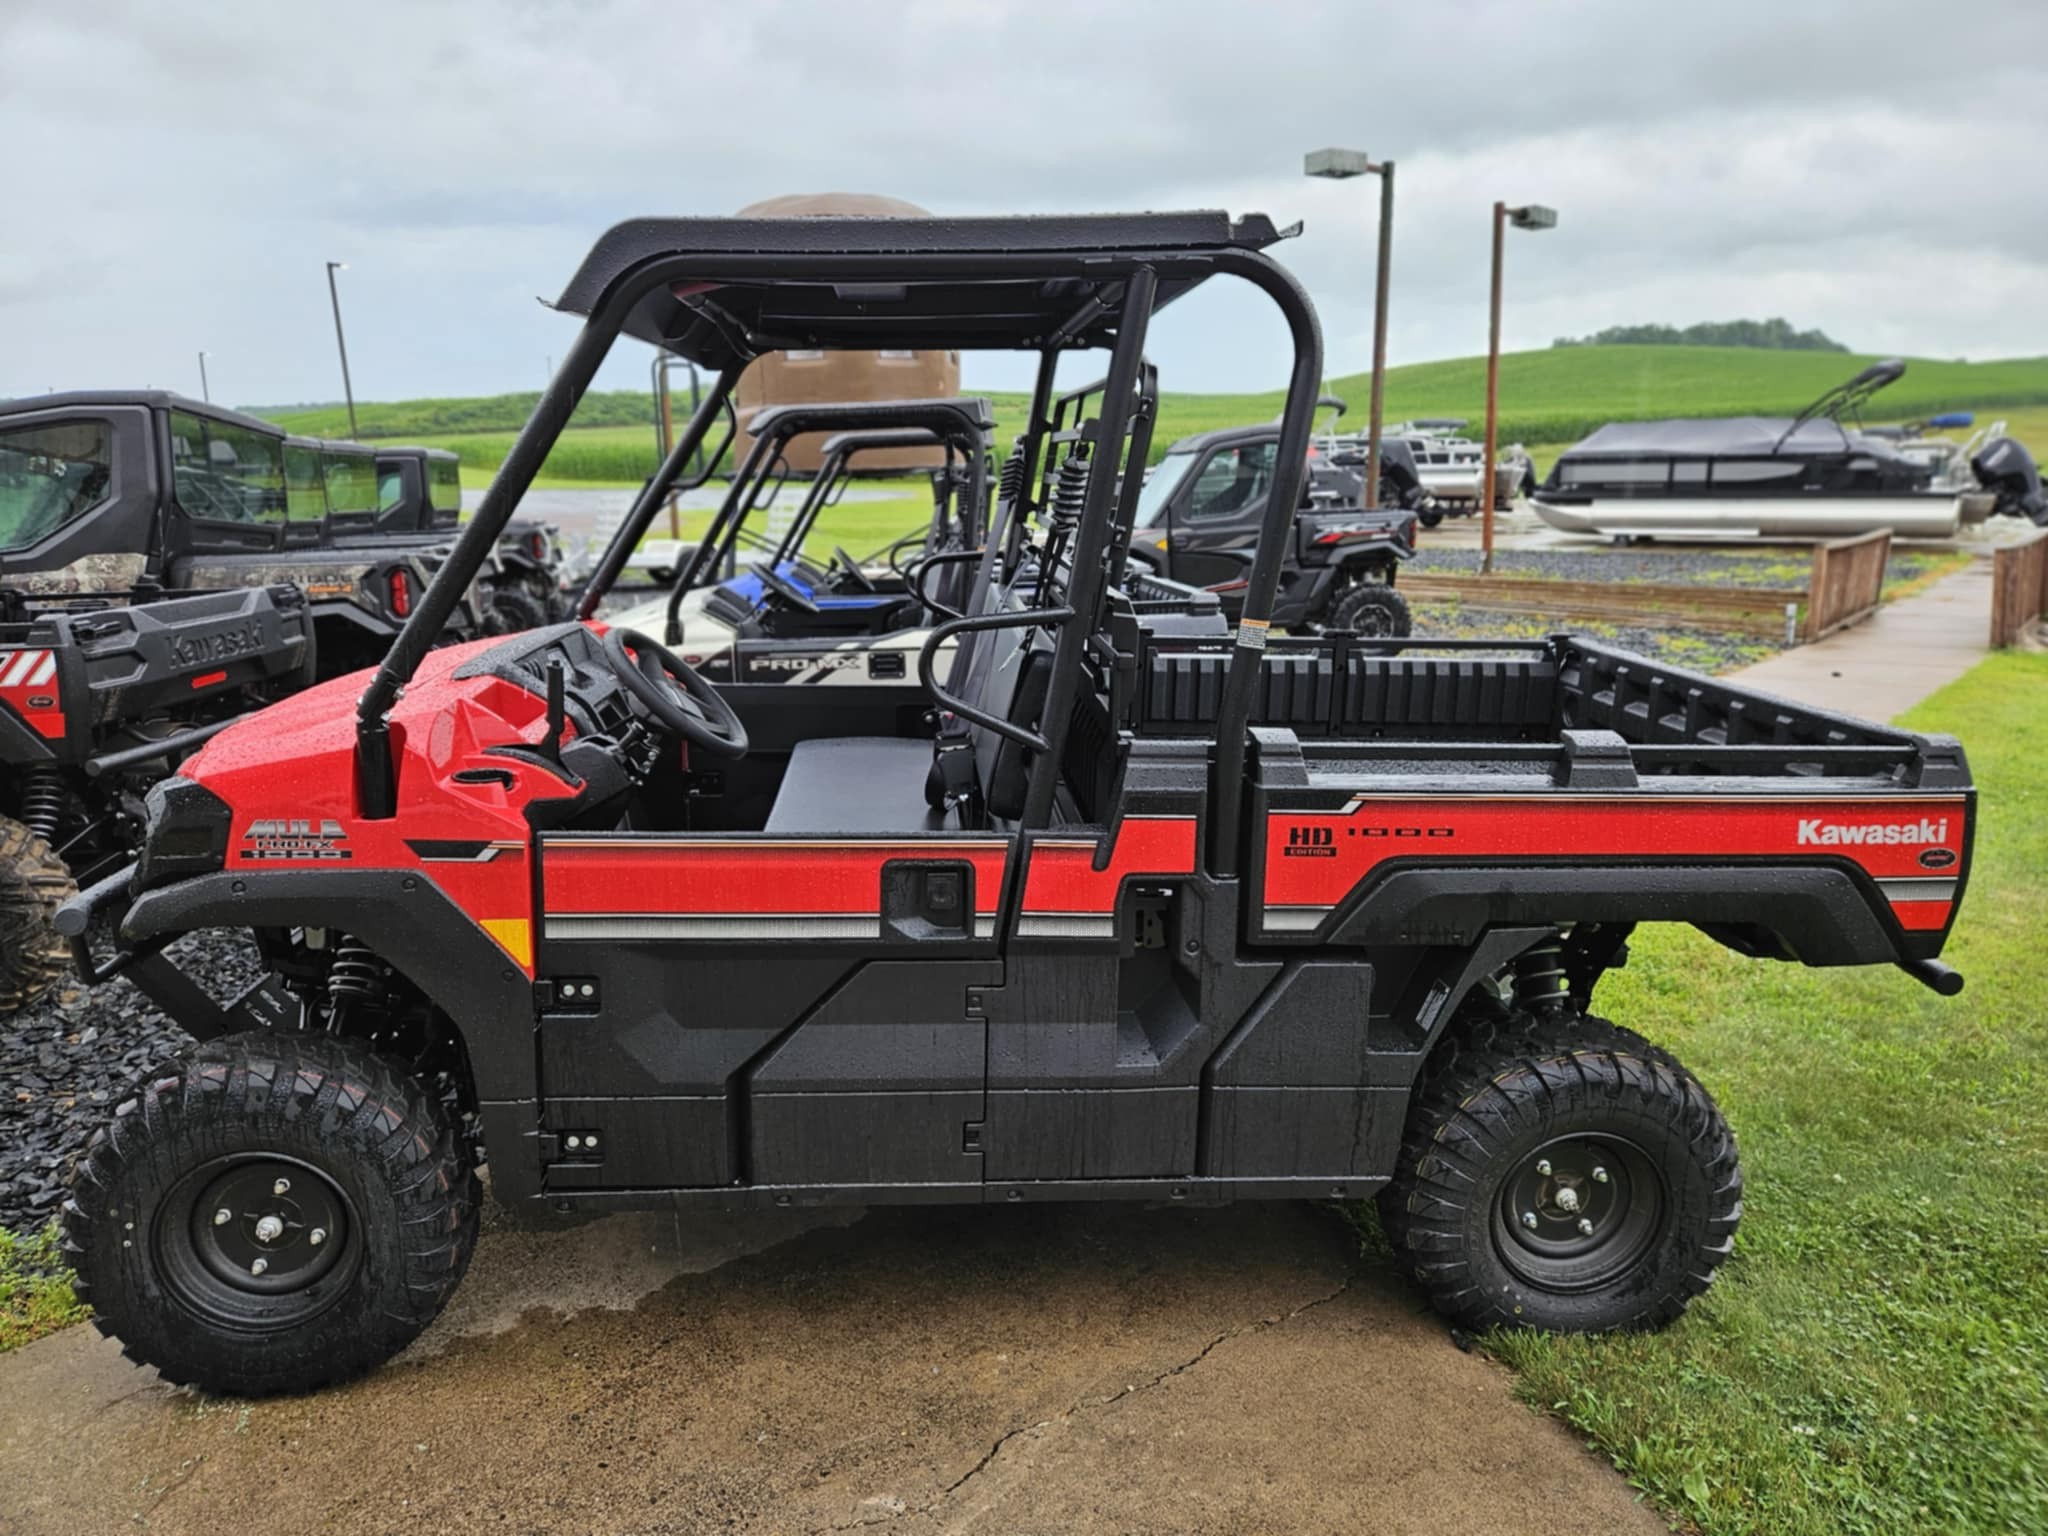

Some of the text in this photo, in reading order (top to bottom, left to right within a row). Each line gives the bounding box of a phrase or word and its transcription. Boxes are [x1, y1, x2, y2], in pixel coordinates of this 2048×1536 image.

[165, 619, 265, 670] Kawasaki
[750, 658, 809, 671] PRO
[243, 819, 347, 840] MULE
[1289, 827, 1333, 846] HD
[1797, 818, 1948, 845] Kawasaki
[1289, 848, 1332, 856] EDITION
